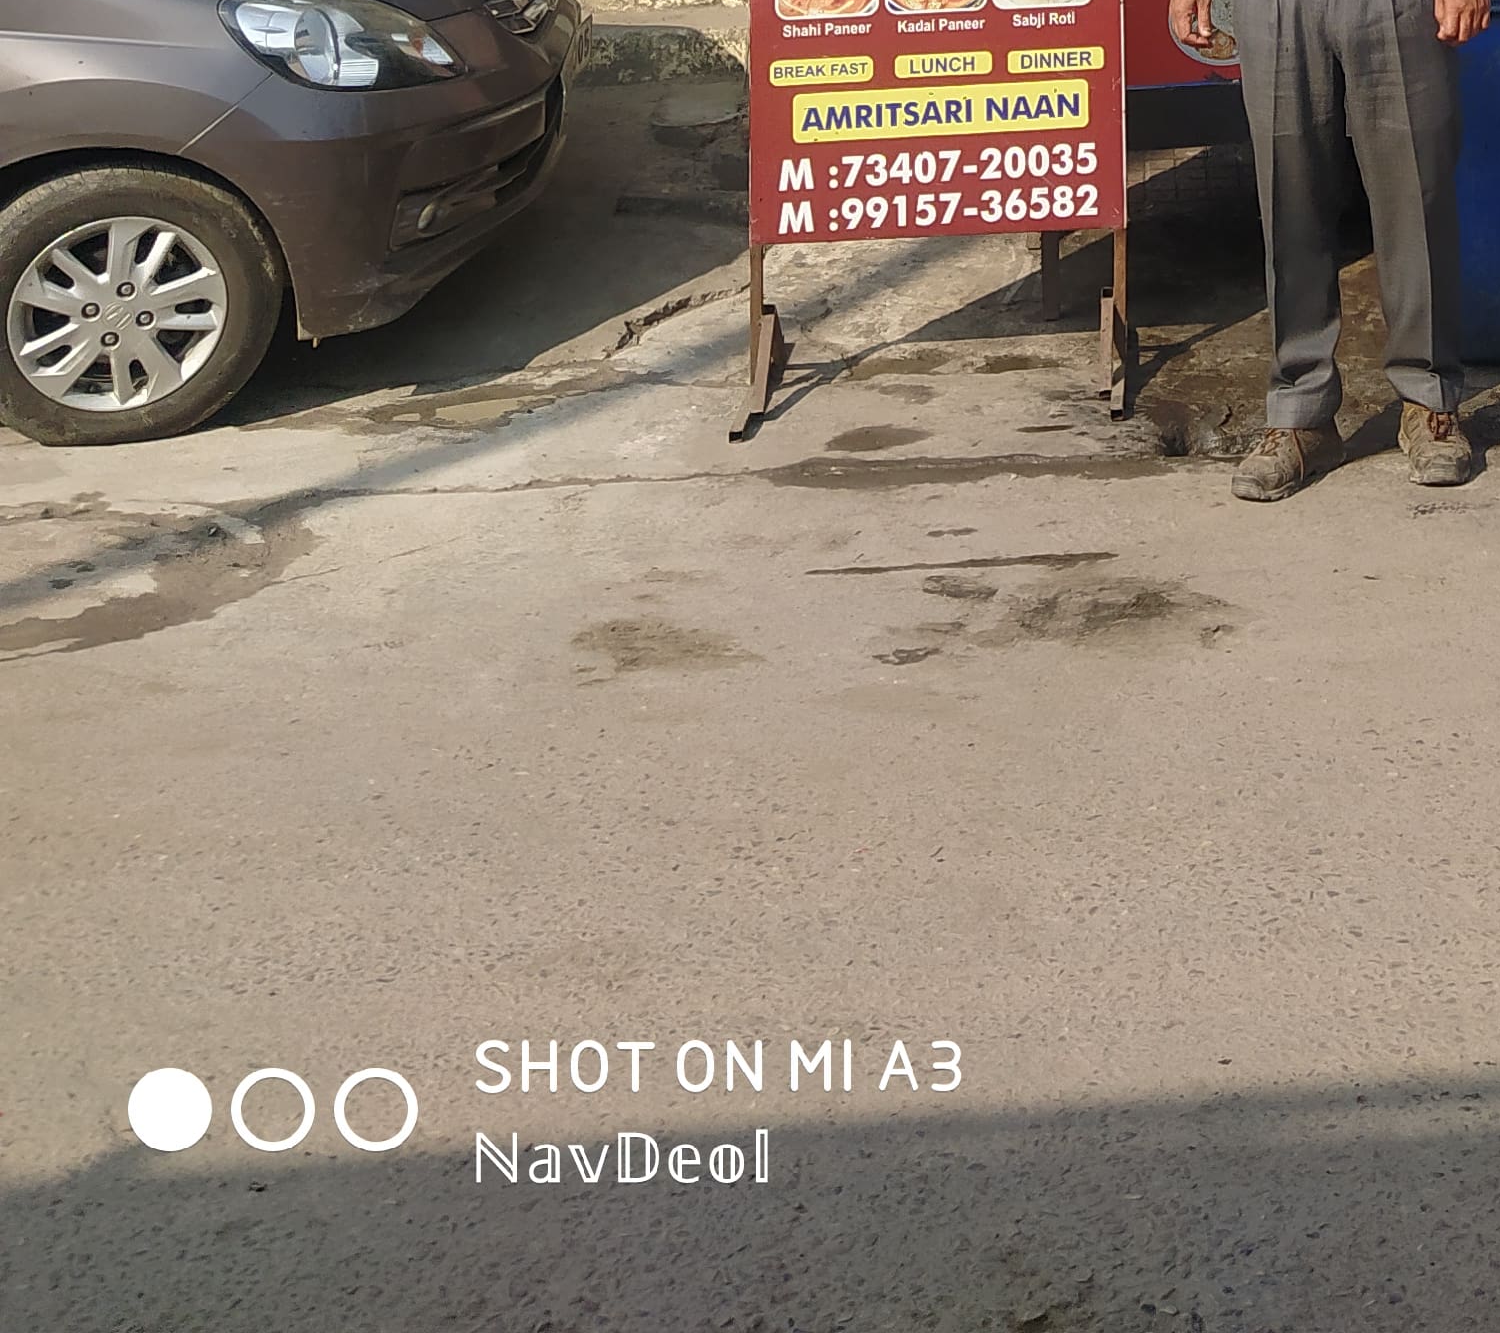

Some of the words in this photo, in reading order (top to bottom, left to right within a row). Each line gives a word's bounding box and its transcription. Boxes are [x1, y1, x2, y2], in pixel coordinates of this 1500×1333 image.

[897, 19, 936, 34] Kadai
[938, 17, 985, 32] Paneer
[1012, 13, 1046, 28] Sabji
[1048, 11, 1076, 26] Roti
[782, 22, 822, 38] Shahi
[824, 21, 872, 37] Paneer
[909, 56, 976, 75] LUNCH
[1020, 50, 1092, 70] DINNER
[773, 63, 827, 80] BREAK
[830, 61, 869, 77] FAST
[800, 98, 973, 132] AMRITSARI
[985, 92, 1080, 122] NAAN
[778, 158, 815, 193] M
[778, 200, 815, 235] M
